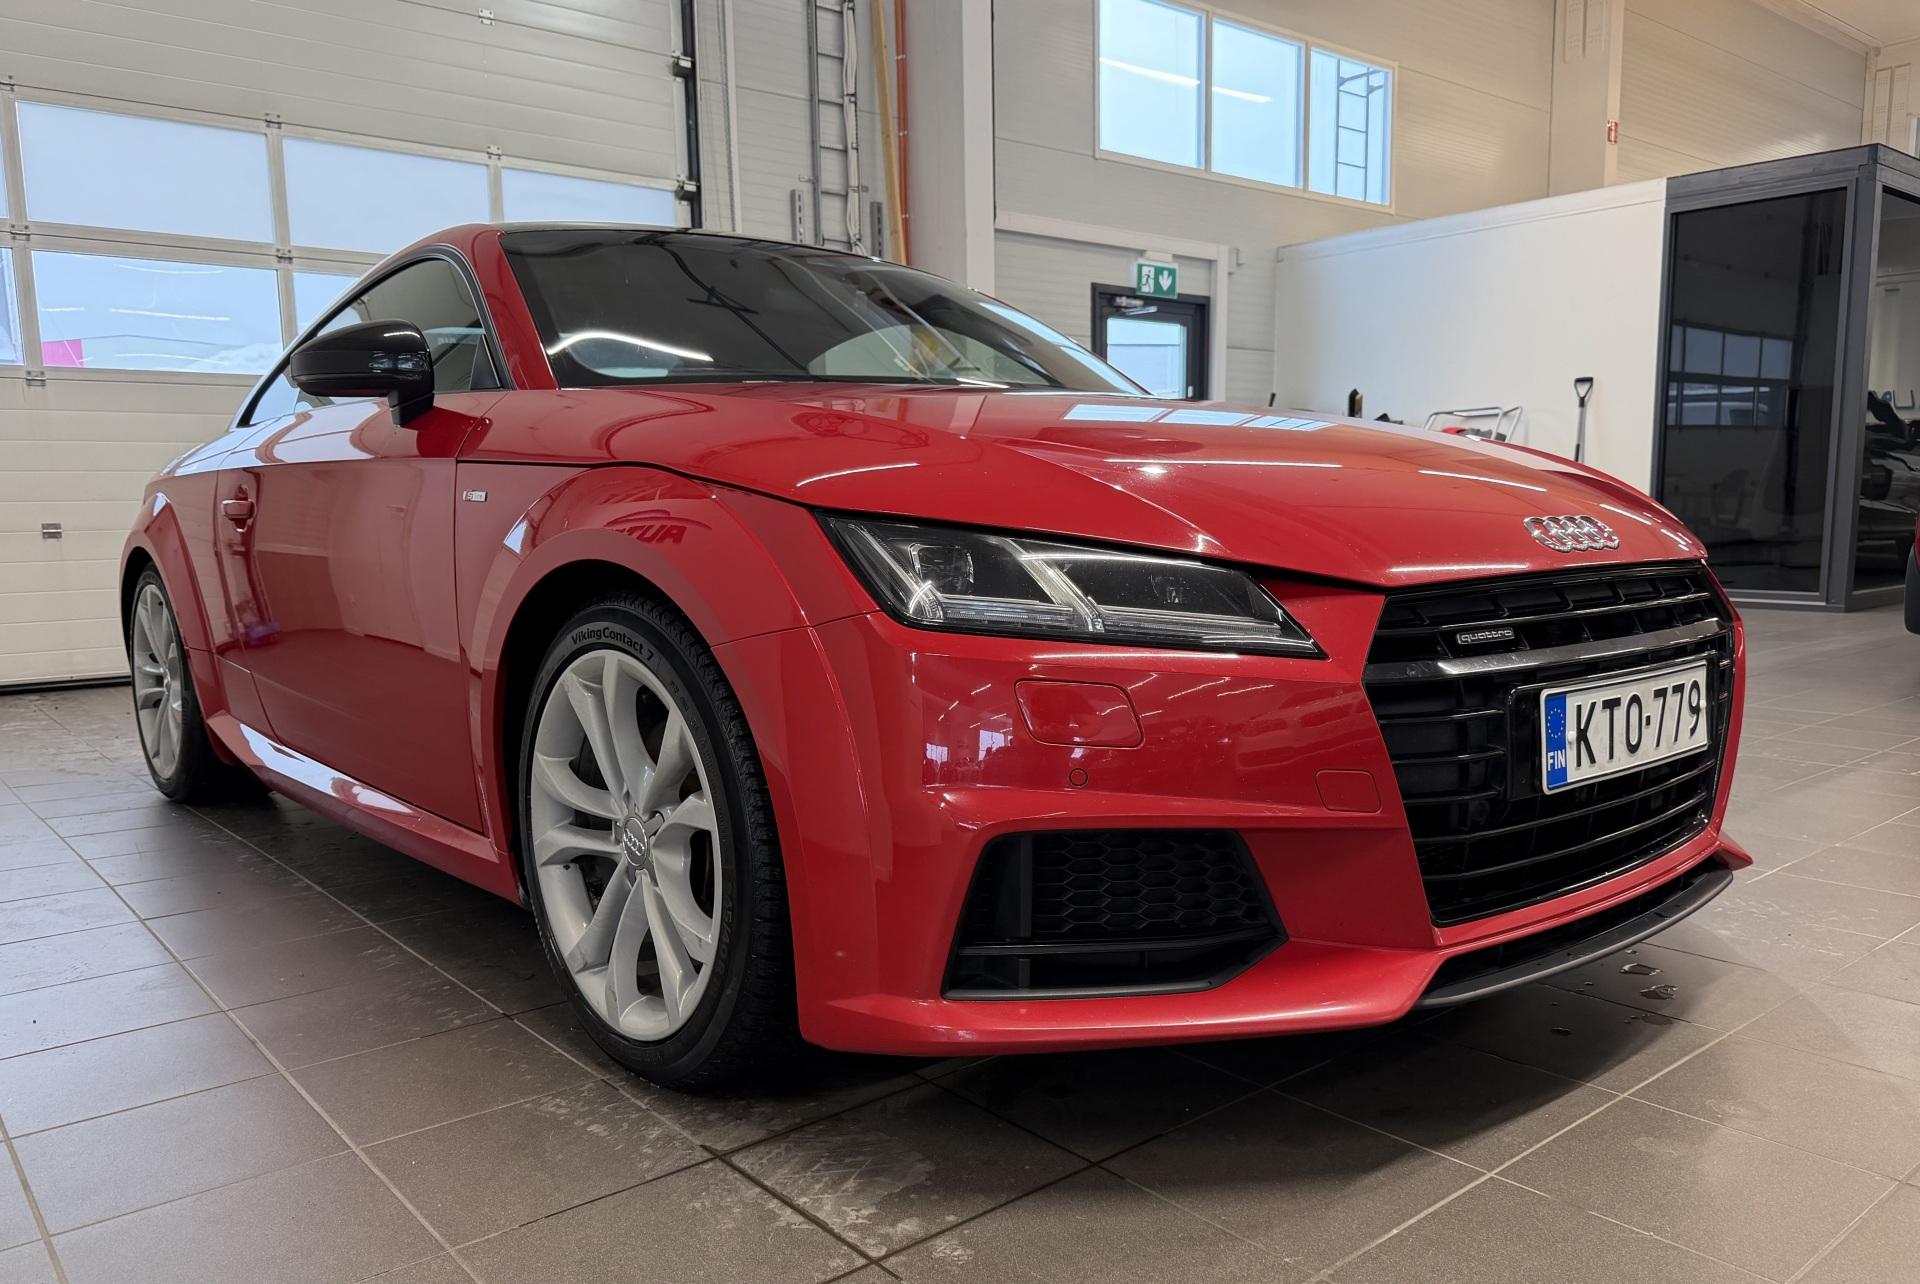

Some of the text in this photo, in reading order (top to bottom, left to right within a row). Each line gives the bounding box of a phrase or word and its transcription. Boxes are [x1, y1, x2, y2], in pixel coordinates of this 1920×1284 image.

[572, 627, 655, 661] VikingContact 7
[1461, 630, 1512, 643] quattro
[1575, 680, 1700, 768] KTO-779
[1547, 749, 1566, 771] FIN
